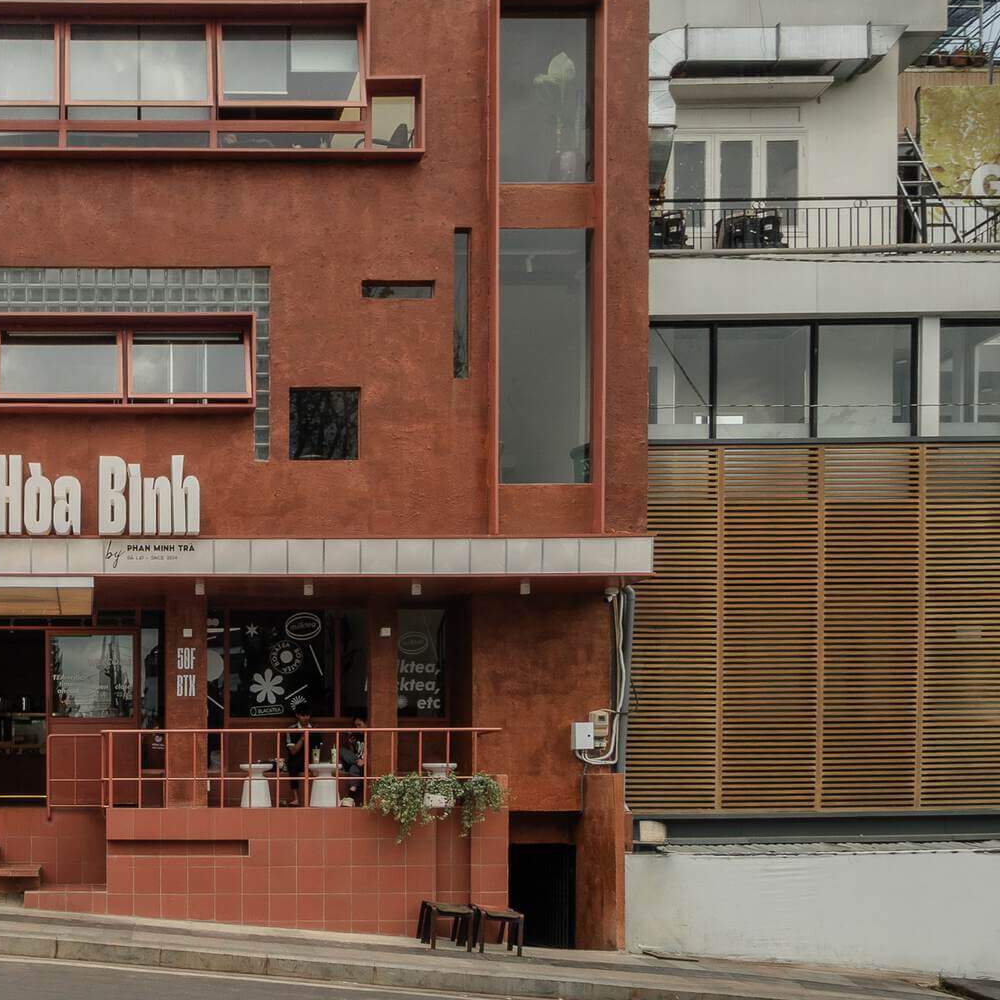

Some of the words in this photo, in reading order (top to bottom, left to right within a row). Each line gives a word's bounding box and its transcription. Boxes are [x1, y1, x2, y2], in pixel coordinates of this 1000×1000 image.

[99, 455, 200, 535] Bình
[397, 659, 441, 676] ktea,
[176, 674, 196, 697] BTX
[396, 677, 441, 695] ktea,
[416, 697, 441, 709] etc
